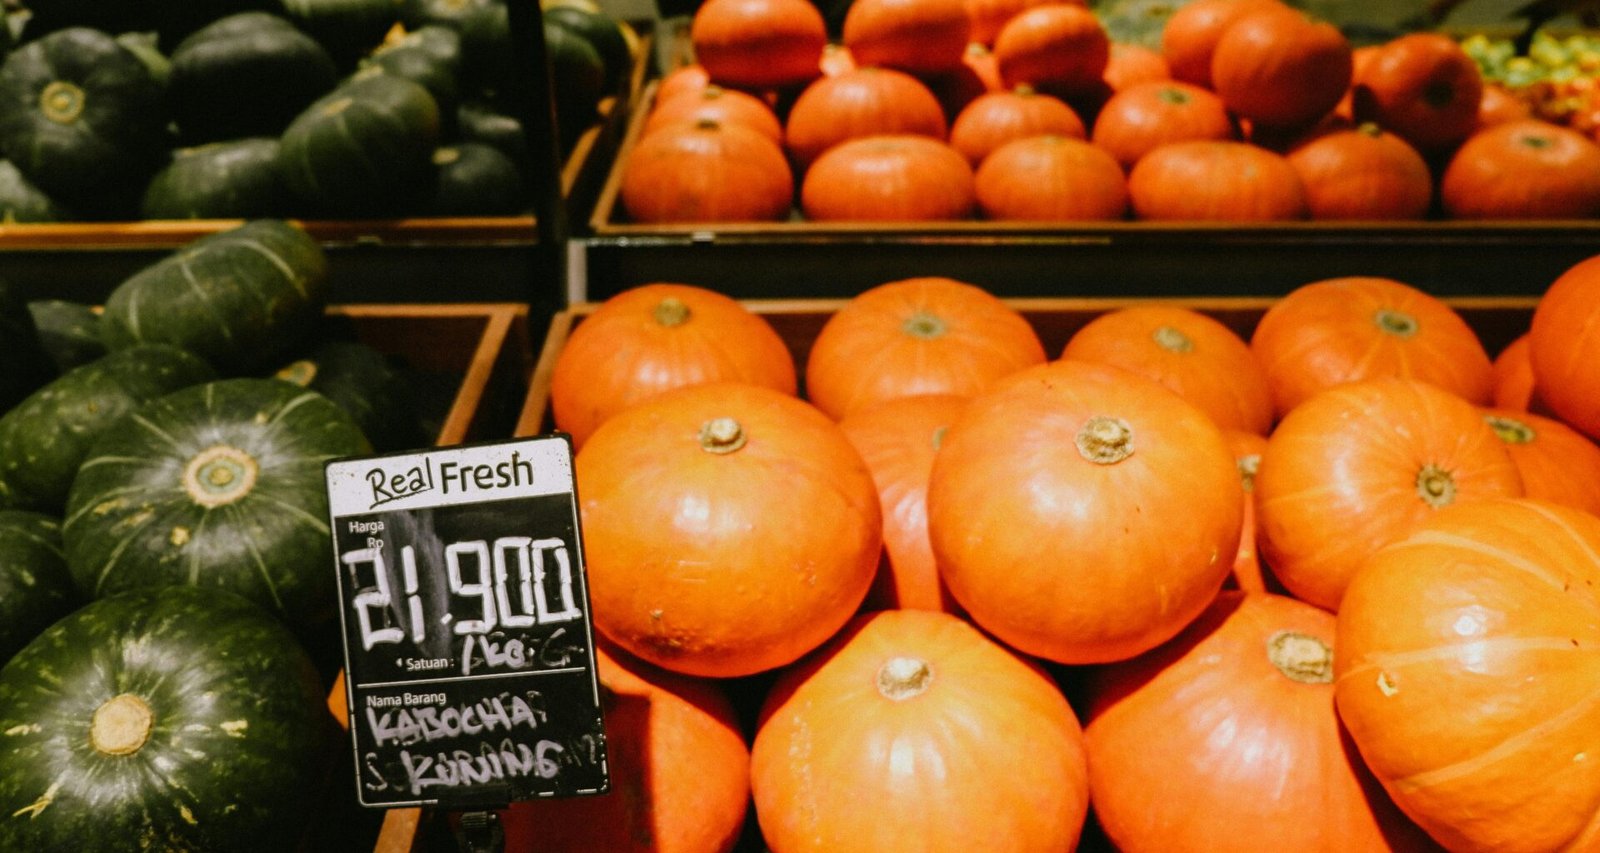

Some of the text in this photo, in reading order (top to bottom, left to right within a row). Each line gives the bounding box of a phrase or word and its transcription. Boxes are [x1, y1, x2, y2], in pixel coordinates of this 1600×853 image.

[366, 451, 534, 509] Real Fresh
[349, 520, 385, 533] Harga
[342, 537, 582, 651] 21.900
[366, 692, 447, 708] Nama Barang
[366, 695, 537, 748] KABOCHA
[399, 739, 564, 796] KUNING
